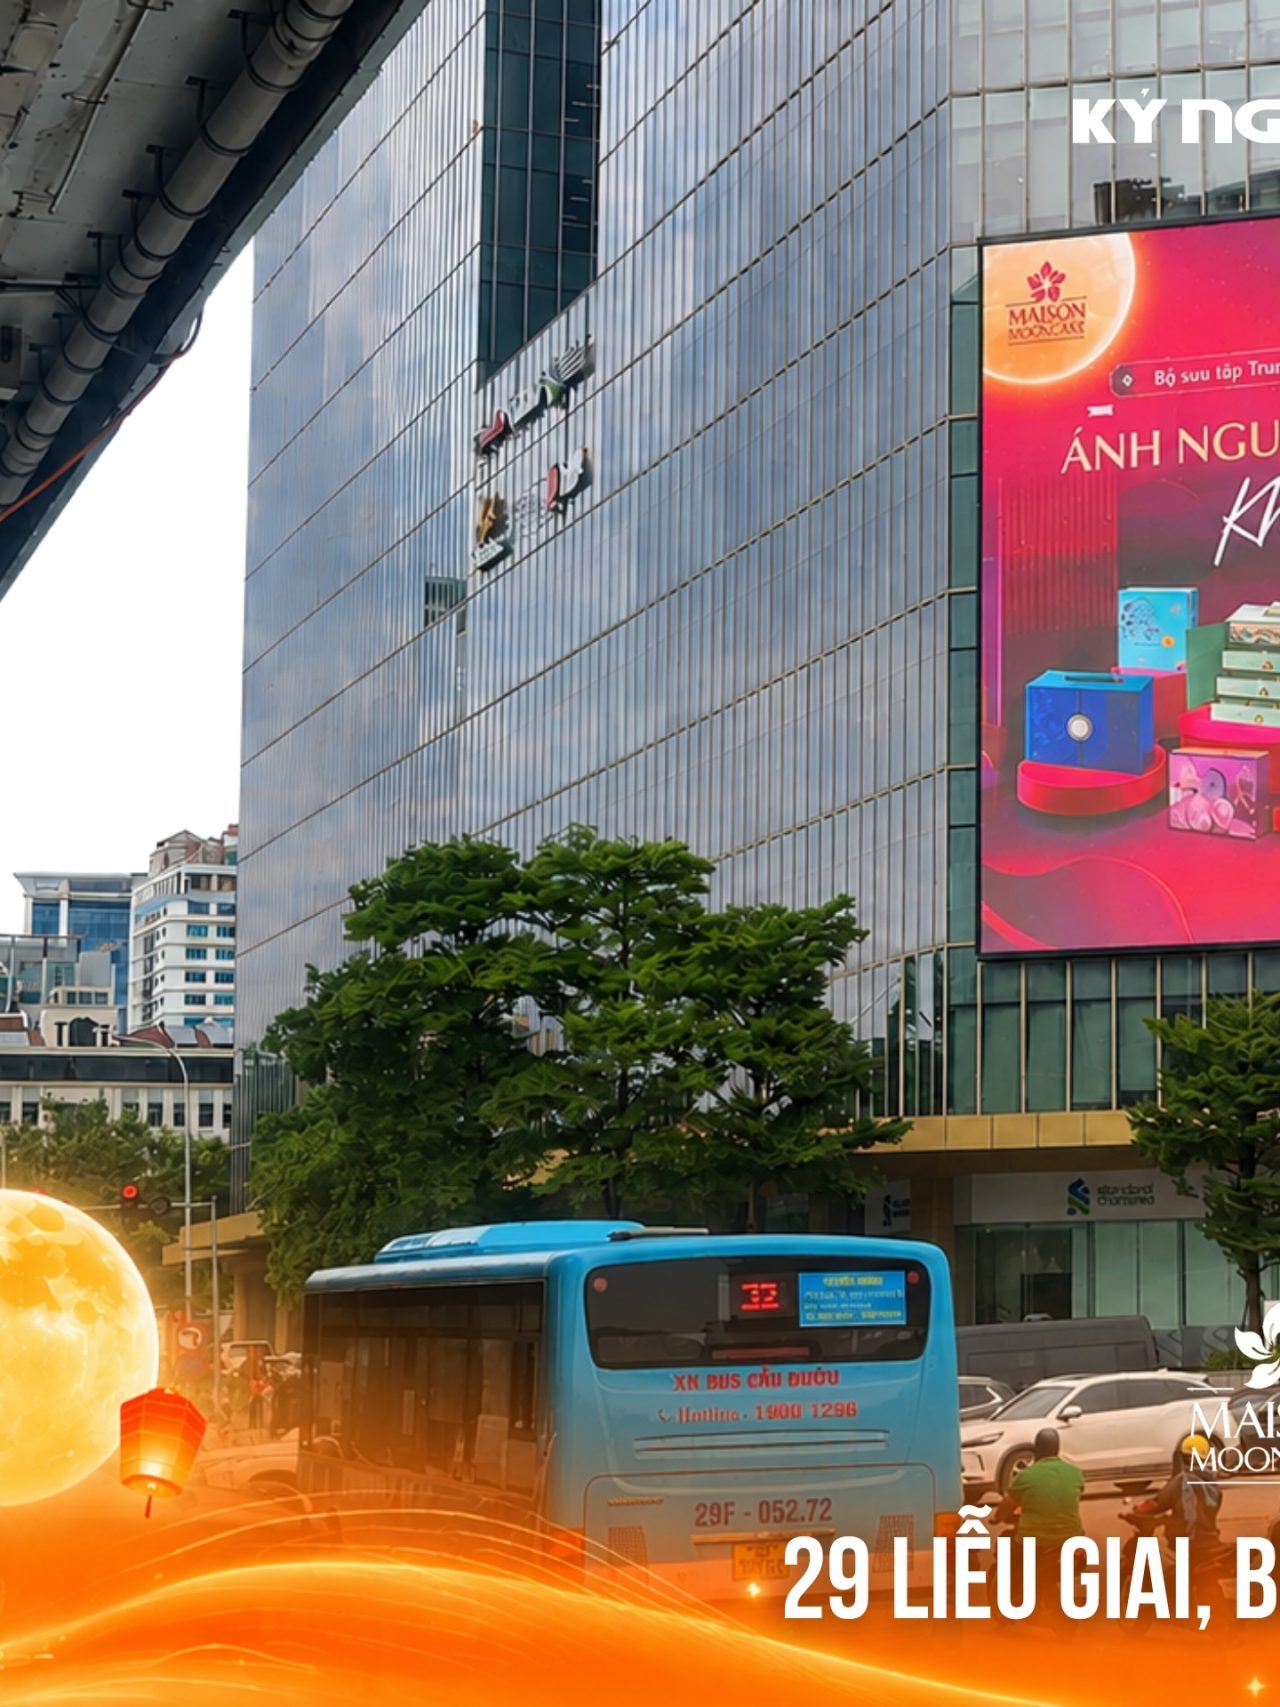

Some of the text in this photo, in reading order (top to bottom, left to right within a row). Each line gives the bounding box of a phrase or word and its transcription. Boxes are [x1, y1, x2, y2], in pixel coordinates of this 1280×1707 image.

[1008, 302, 1086, 326] MAISON
[1061, 426, 1161, 475] ÁNH
[706, 1372, 741, 1390] BUS
[755, 1403, 802, 1420] 1900
[811, 1402, 858, 1418] 1296
[694, 1501, 736, 1527] 29F
[758, 1497, 833, 1524] 052.72
